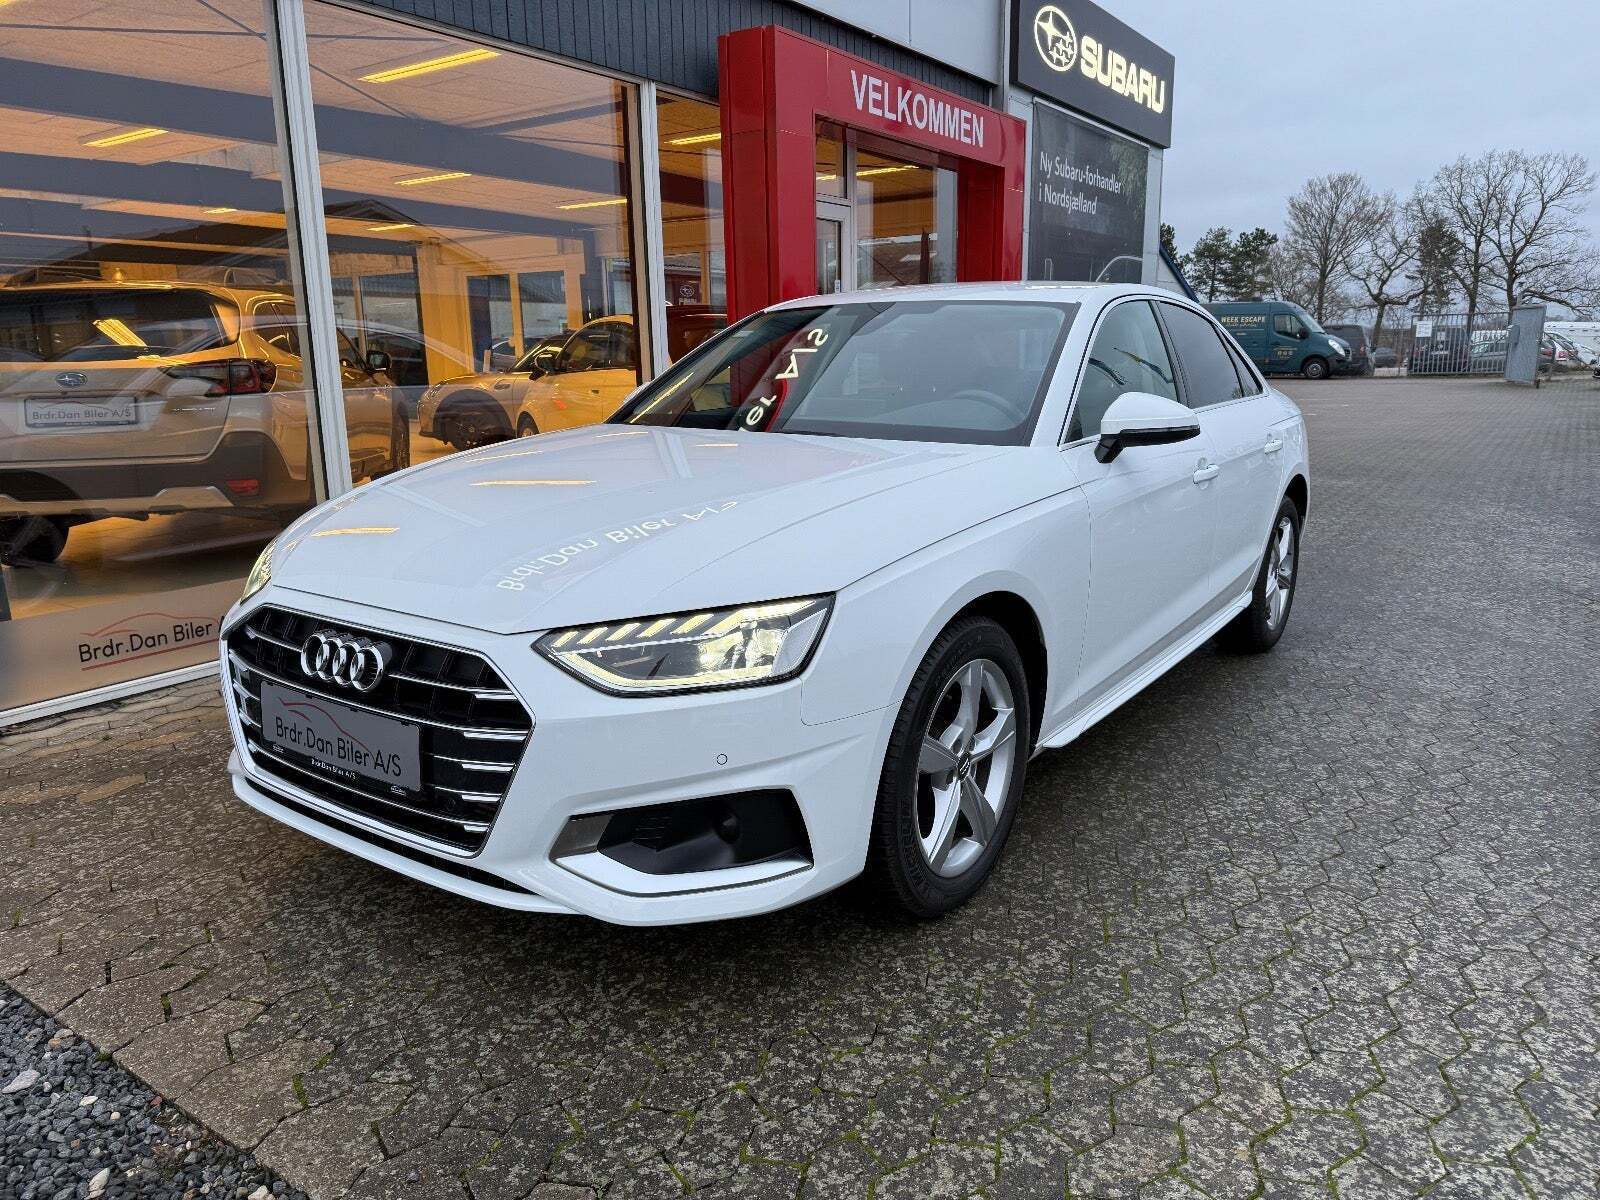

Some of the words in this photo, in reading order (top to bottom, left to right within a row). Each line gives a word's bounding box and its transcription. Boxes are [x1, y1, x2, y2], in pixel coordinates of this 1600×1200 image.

[1080, 35, 1165, 114] SUBARU
[851, 69, 984, 148] VELKOMMEN
[1040, 151, 1053, 179] Ny
[1054, 156, 1121, 194] Subaru-forhandler
[1038, 182, 1042, 202] i
[1044, 183, 1098, 215] Nordsjælland
[32, 410, 80, 420] Brdr.Dan
[84, 409, 108, 418] Biler
[111, 407, 131, 417] A/S
[78, 633, 168, 662] Brdr.Dan
[173, 622, 213, 642] Biler
[275, 716, 334, 755] Brdr.Dan
[337, 737, 370, 767] Biler
[374, 750, 402, 777] A/S
